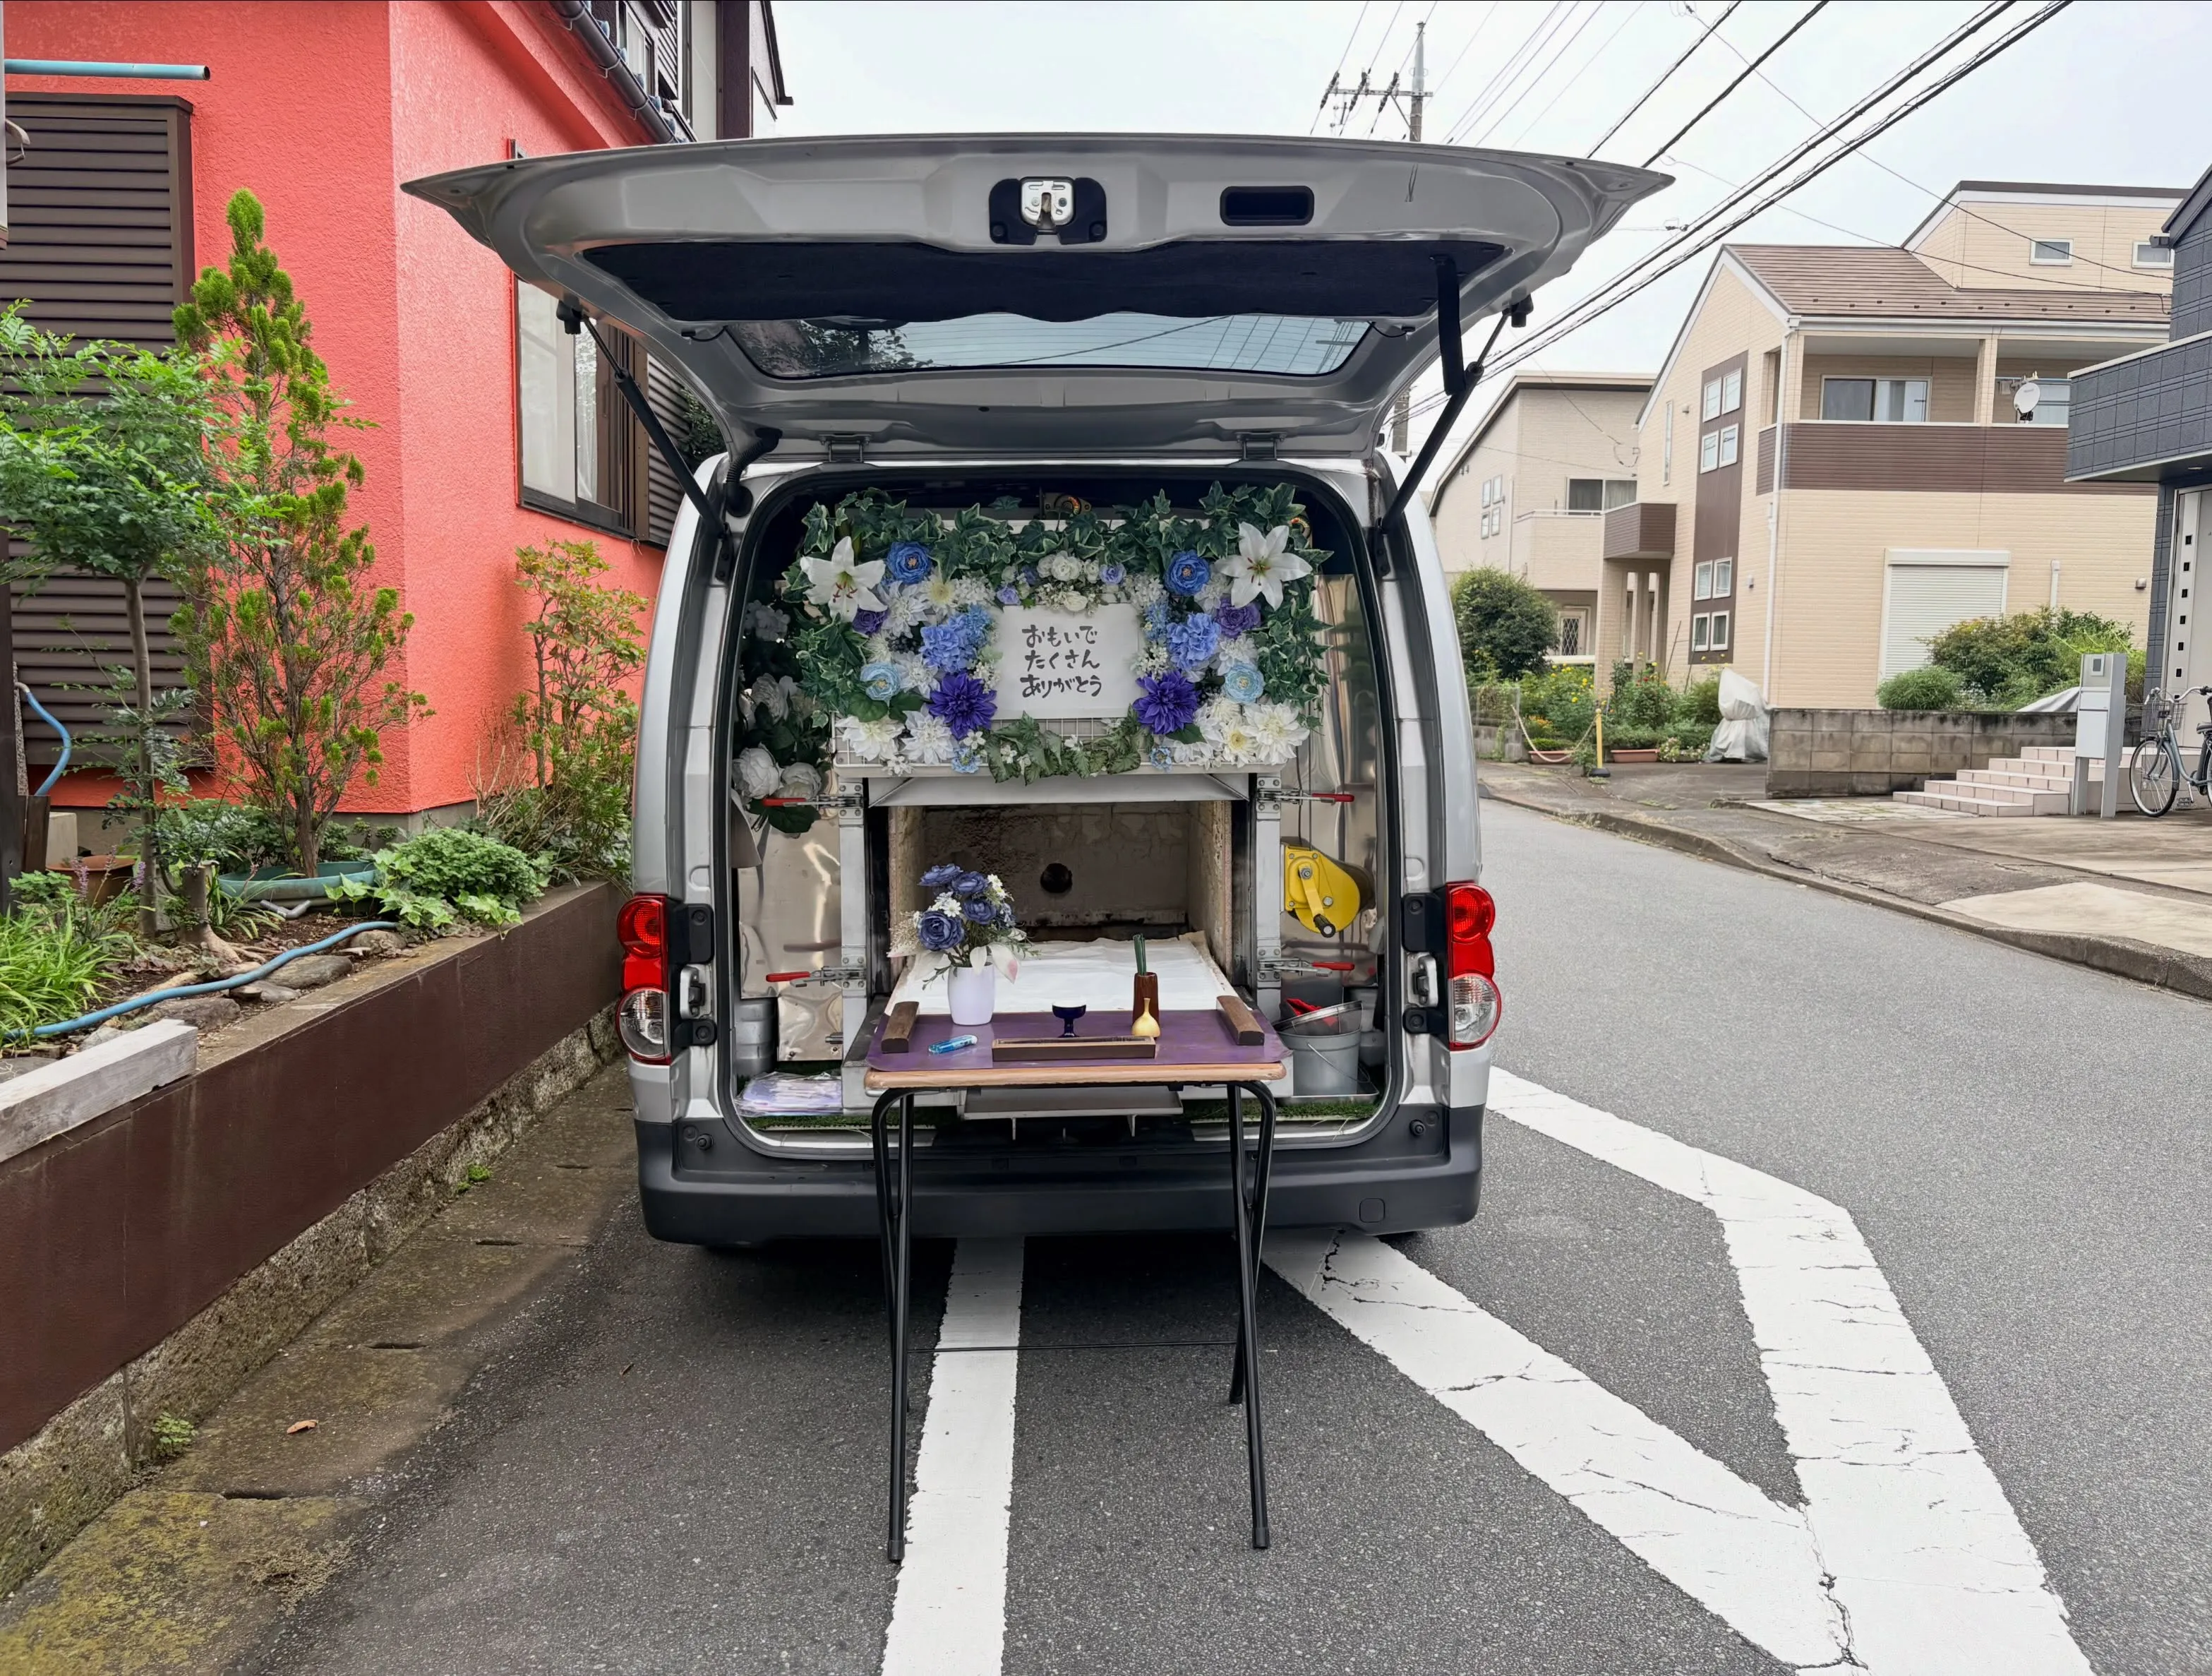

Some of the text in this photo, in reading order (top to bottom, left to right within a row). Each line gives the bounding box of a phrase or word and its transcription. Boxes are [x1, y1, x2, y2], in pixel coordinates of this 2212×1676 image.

[1021, 624, 1098, 648] おもいで
[1024, 649, 1100, 672] たくさん
[1019, 674, 1102, 699] ありがとう
